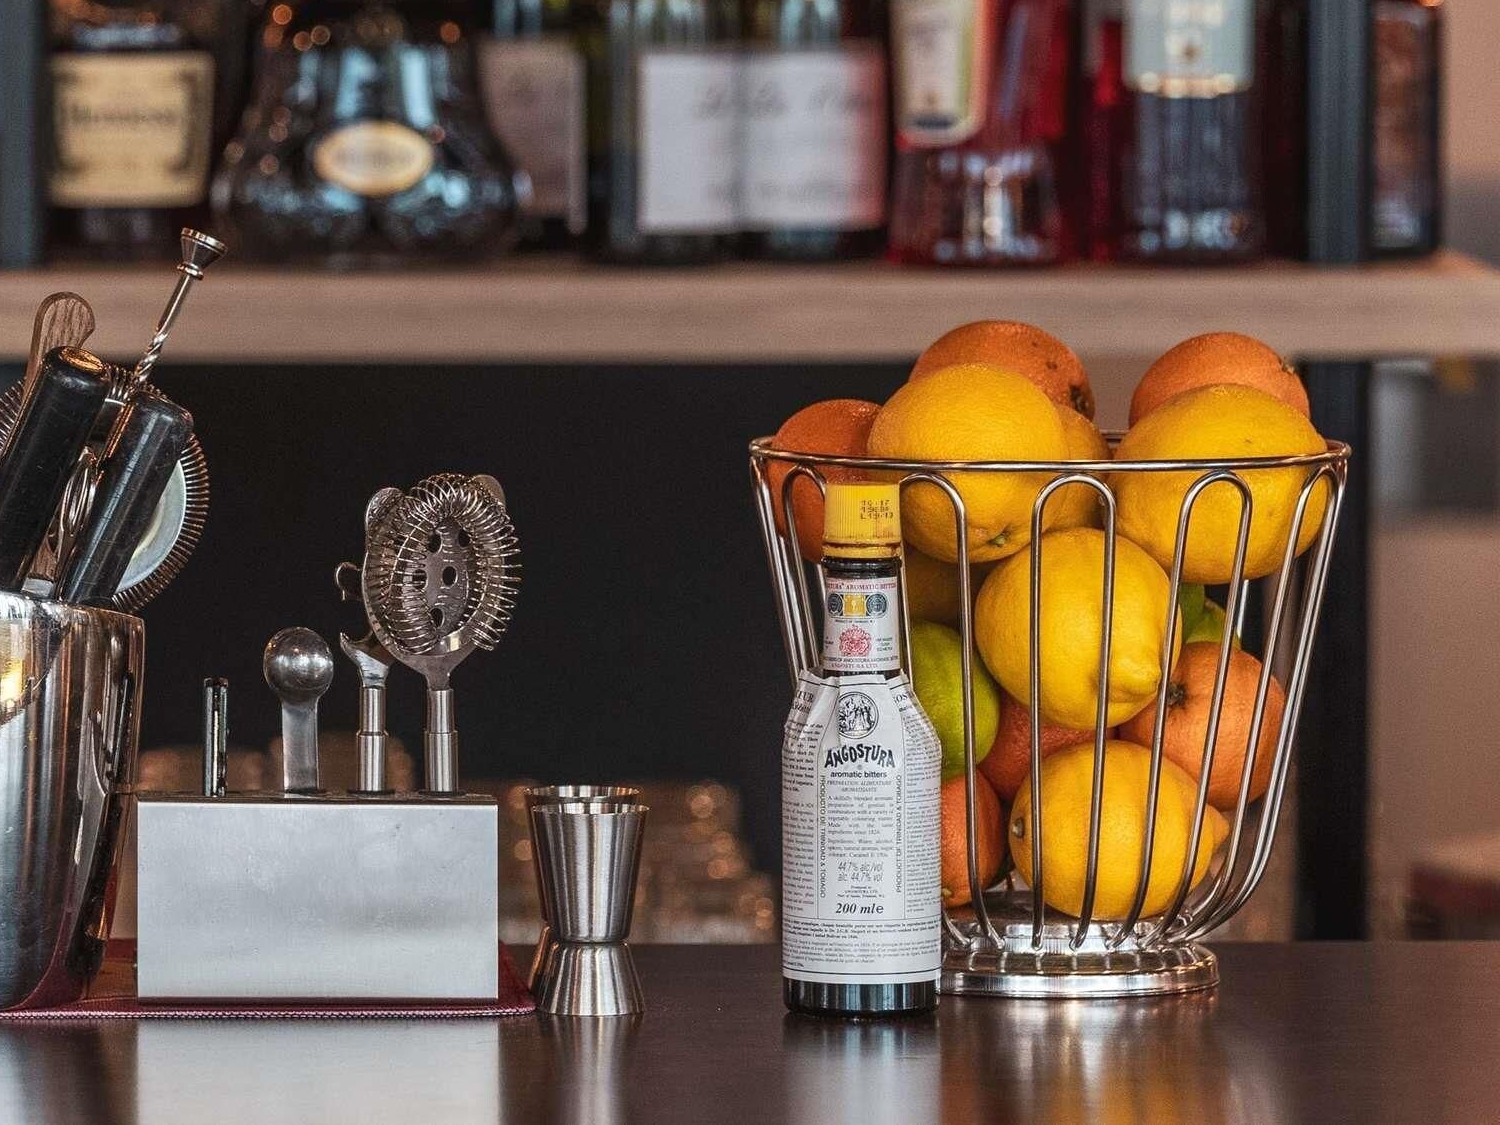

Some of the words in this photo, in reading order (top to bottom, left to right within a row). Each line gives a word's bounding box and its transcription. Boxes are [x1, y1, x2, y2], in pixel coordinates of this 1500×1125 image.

[824, 743, 895, 768] ANGOSTURA
[896, 847, 901, 857] OF
[836, 903, 857, 914] 200
